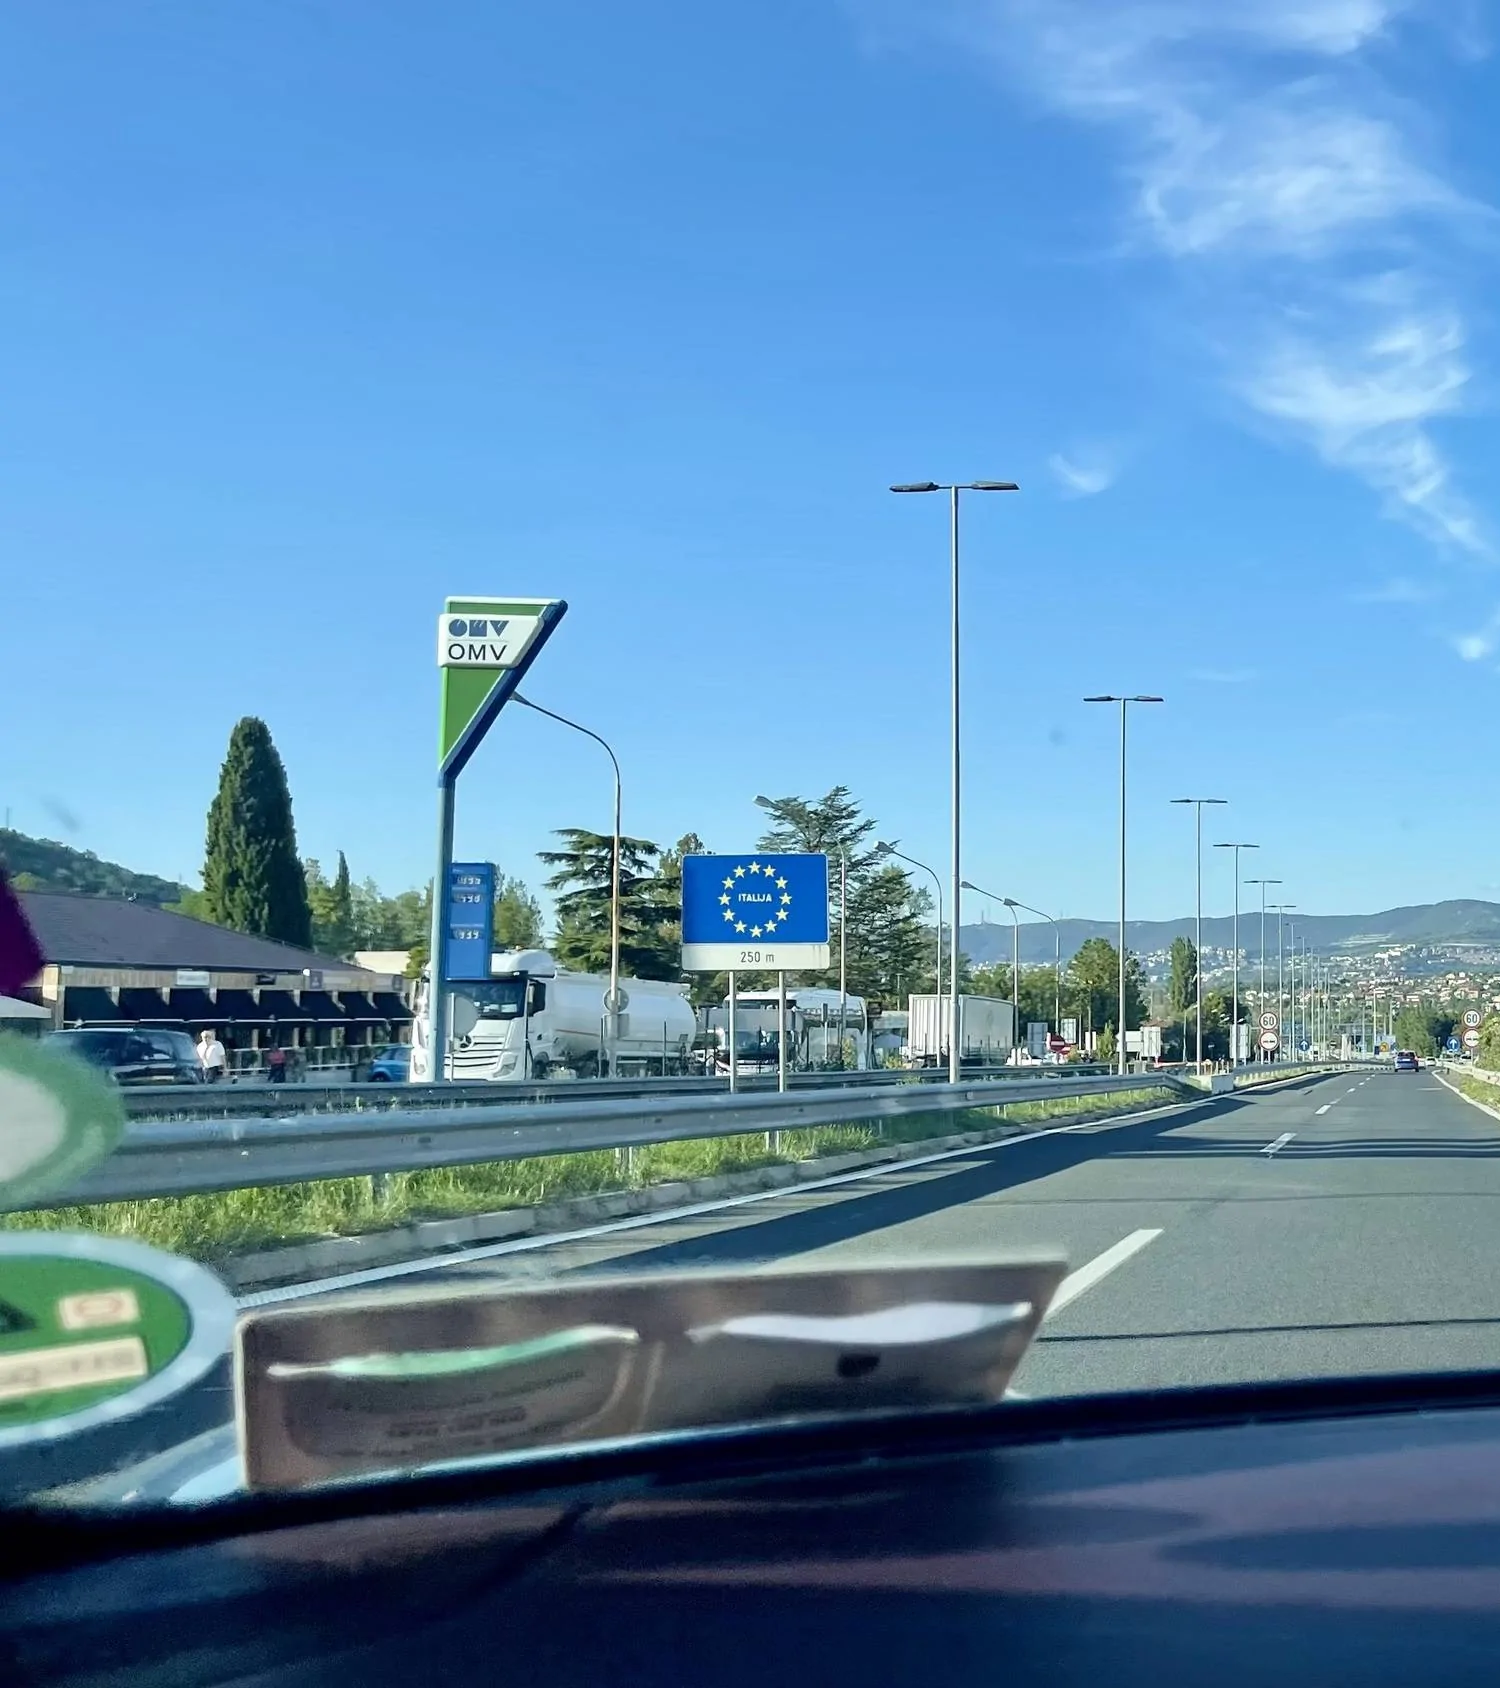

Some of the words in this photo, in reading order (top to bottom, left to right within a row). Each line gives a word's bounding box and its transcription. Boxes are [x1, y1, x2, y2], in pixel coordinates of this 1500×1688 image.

[448, 643, 507, 660] OMV
[738, 893, 772, 902] ITALIJA
[740, 951, 761, 963] 250
[765, 953, 775, 963] m
[1263, 1015, 1275, 1026] 60
[1467, 1013, 1478, 1024] 60
